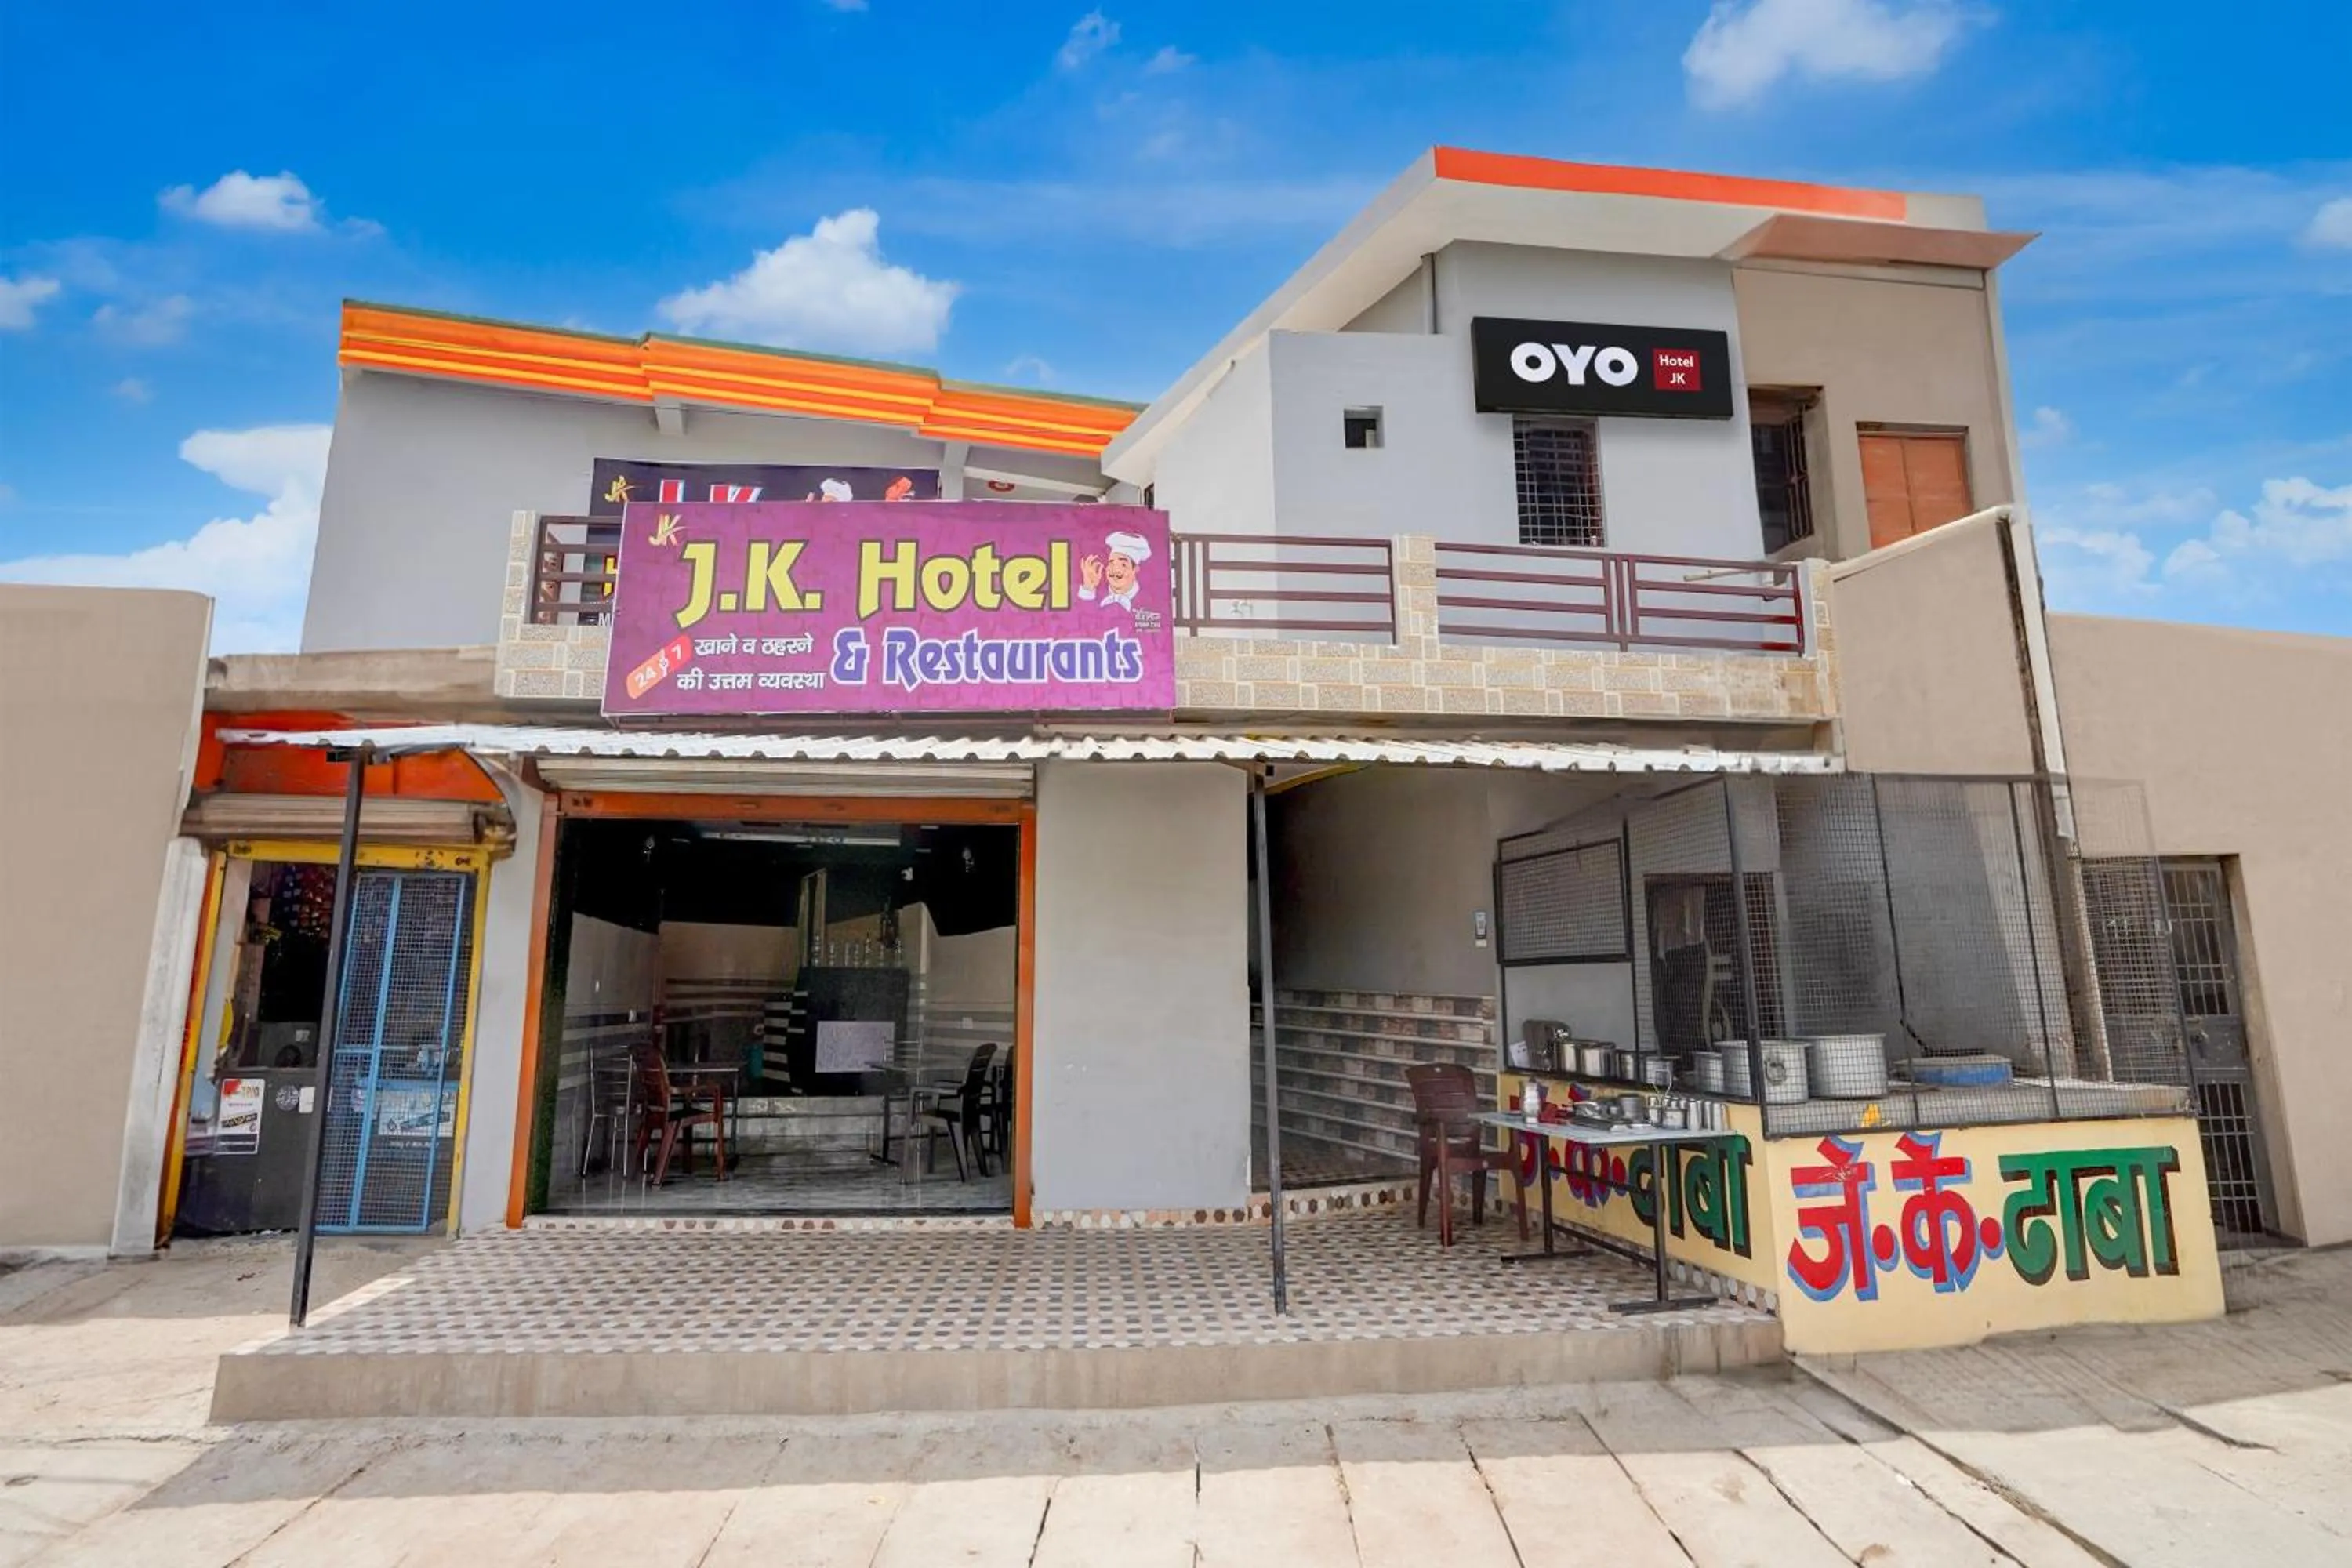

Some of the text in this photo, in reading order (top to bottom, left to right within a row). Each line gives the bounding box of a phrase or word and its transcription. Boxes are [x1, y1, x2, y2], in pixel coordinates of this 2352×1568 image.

[1510, 342, 1639, 386] OYO
[1659, 354, 1694, 368] Hotel
[1669, 372, 1686, 384] JK
[676, 539, 1071, 629] J.K. Hotel
[695, 633, 814, 656] खाने व ठहरने
[831, 627, 1144, 692] & Restaurants
[677, 666, 827, 690] की उत्तम व्यवस्था
